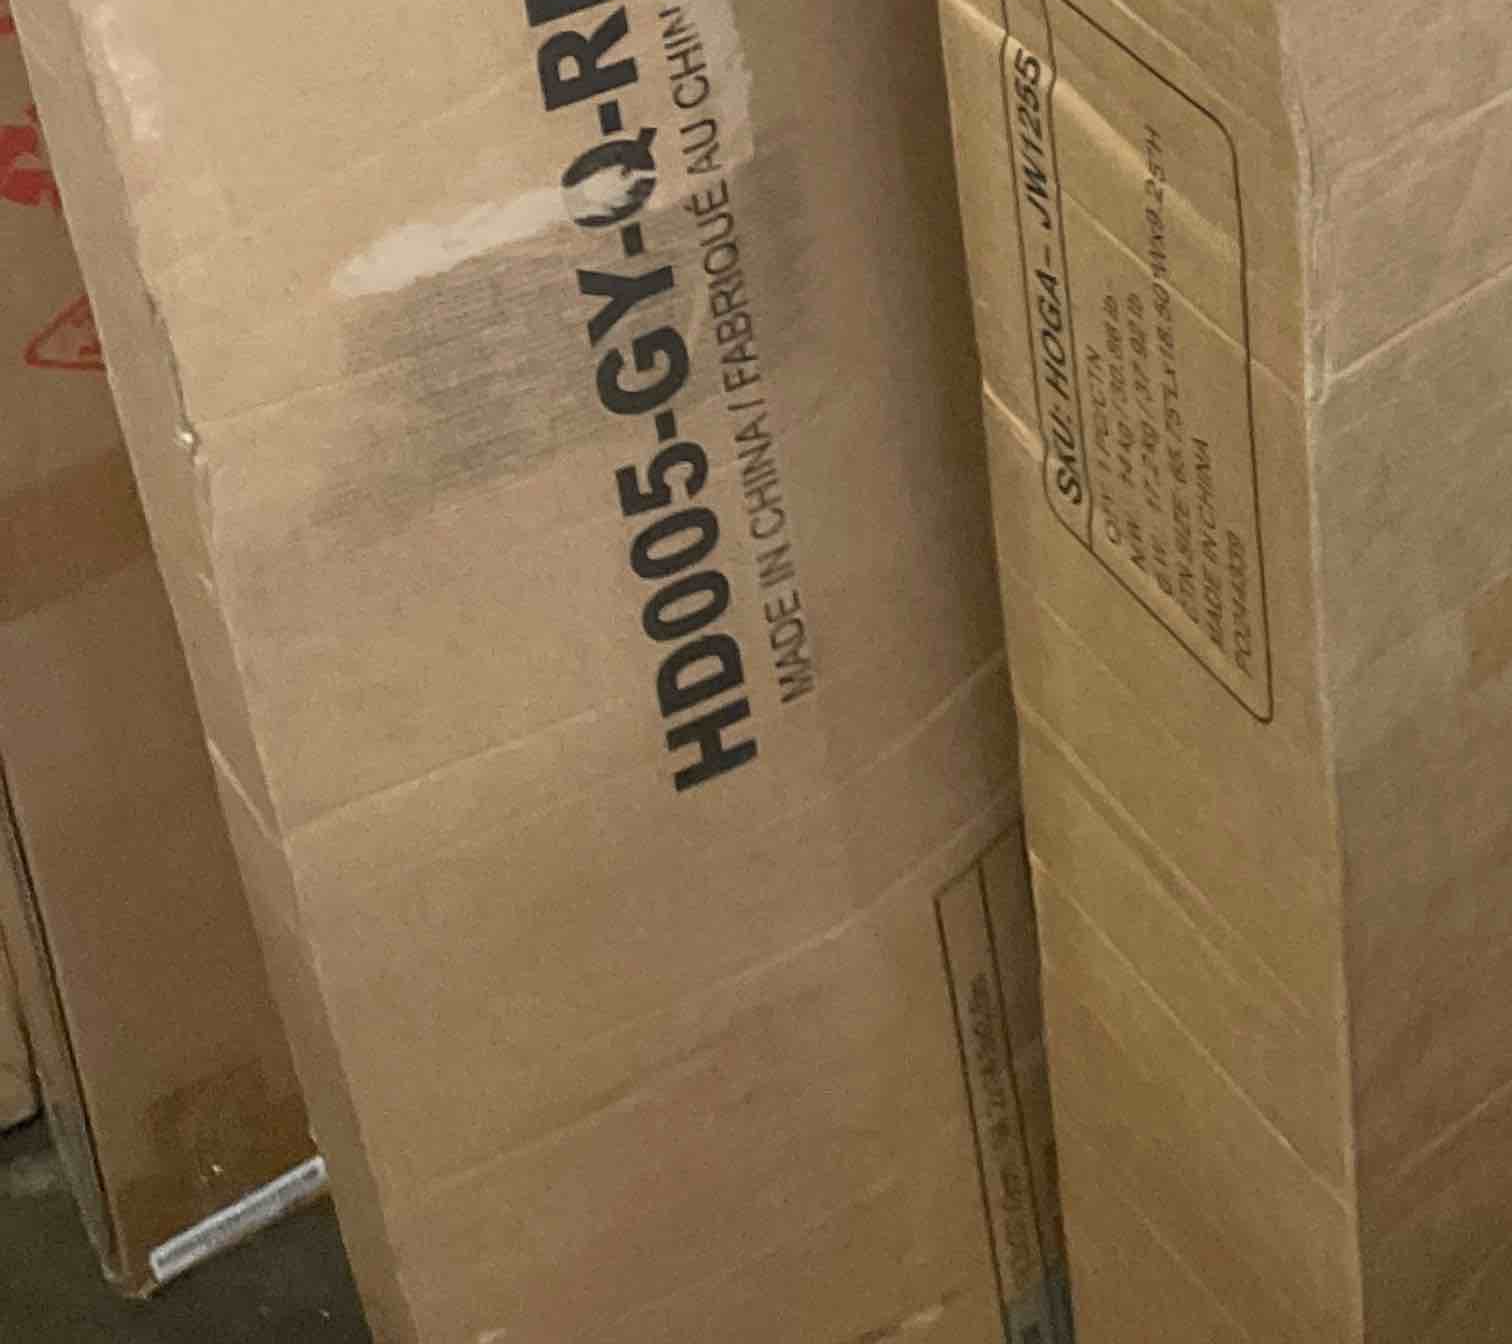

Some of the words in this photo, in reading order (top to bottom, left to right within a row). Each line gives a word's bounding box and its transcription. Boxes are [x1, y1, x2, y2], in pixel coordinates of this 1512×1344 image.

[679, 116, 722, 175] AU
[1013, 47, 1051, 232] JW1255
[685, 177, 762, 393] FABRIQUÉ
[734, 410, 787, 540] CHINA
[1056, 414, 1084, 506] SKU:
[755, 543, 796, 589] IN
[765, 588, 815, 704] MADE
